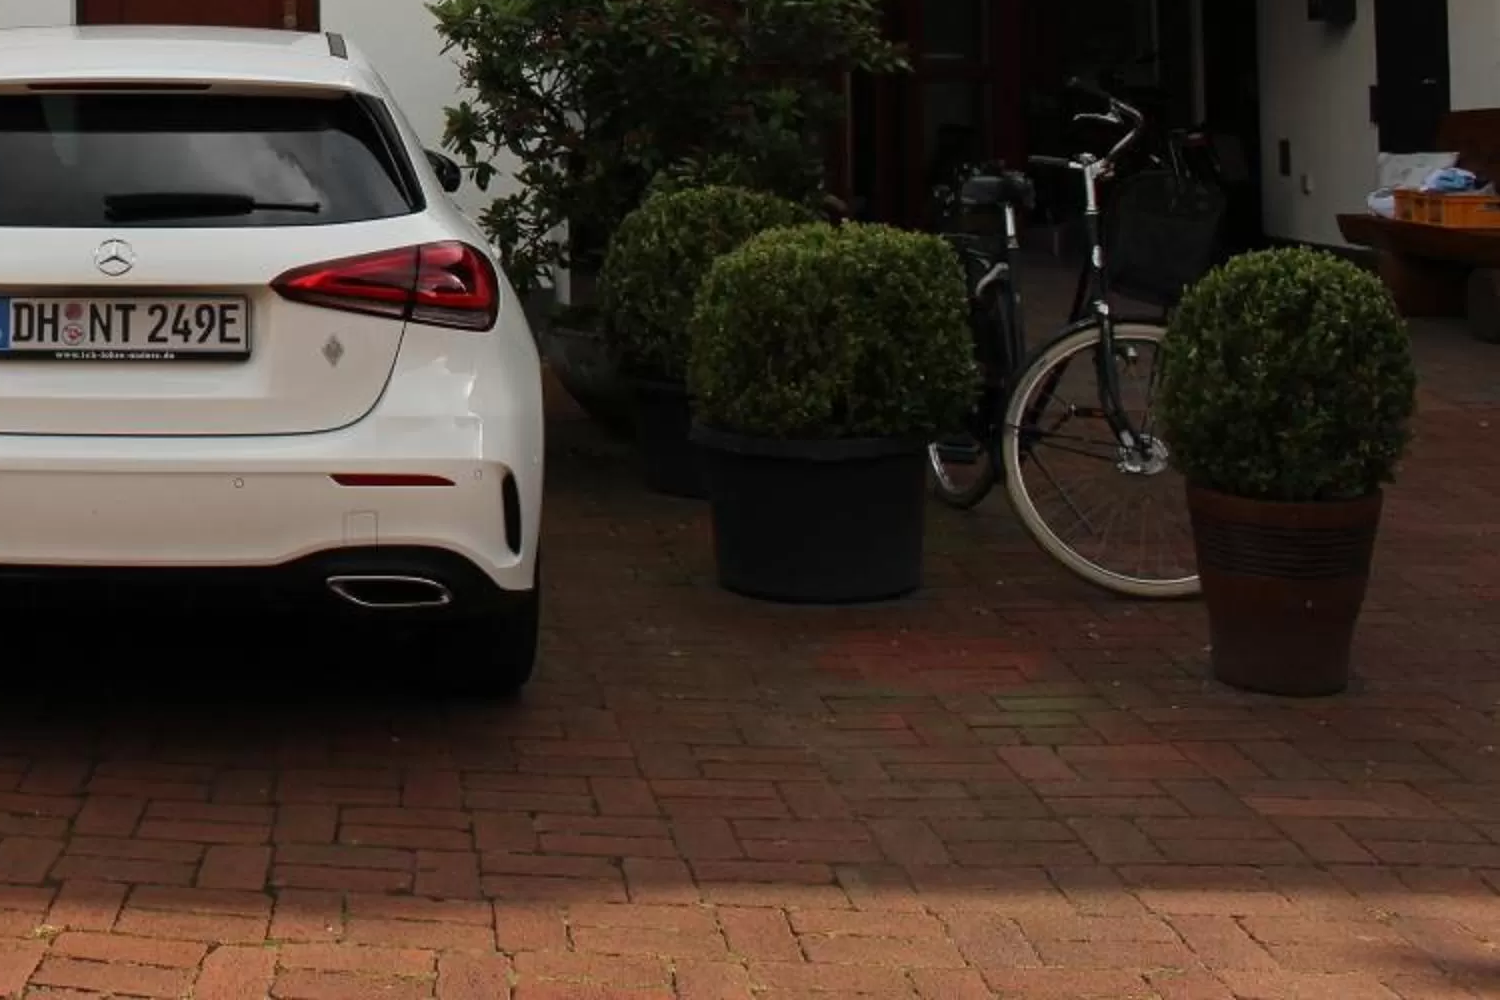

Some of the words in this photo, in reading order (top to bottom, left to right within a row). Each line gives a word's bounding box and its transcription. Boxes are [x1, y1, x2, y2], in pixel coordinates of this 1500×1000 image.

[13, 303, 59, 342] DH
[90, 304, 136, 342] NT
[147, 304, 241, 343] 249E
